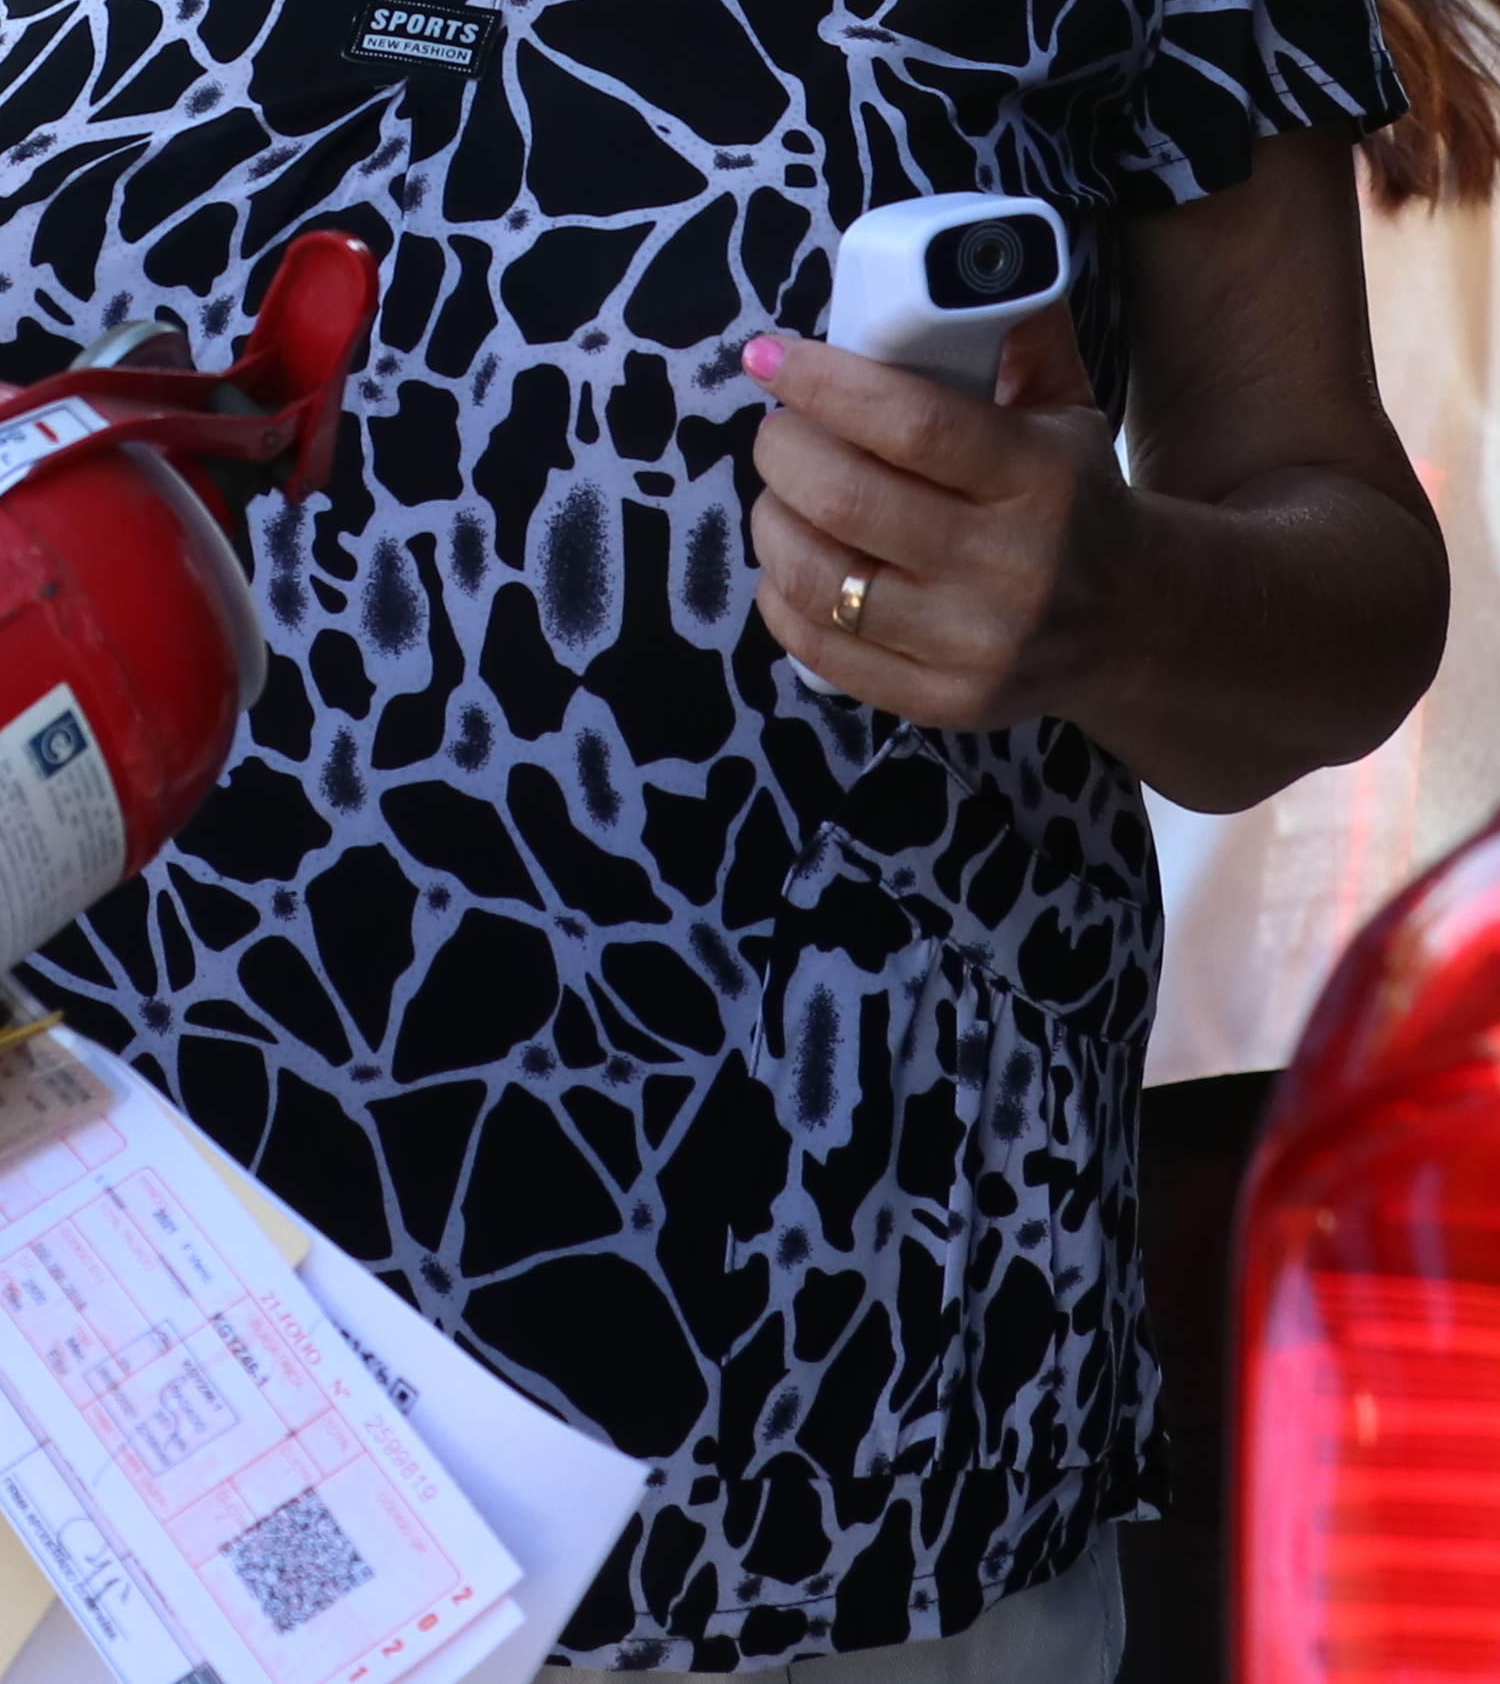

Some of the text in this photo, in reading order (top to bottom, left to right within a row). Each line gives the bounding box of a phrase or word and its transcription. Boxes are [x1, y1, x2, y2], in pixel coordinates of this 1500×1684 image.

[370, 8, 480, 44] SPORTS
[367, 37, 468, 62] NEW FASHION
[362, 1413, 439, 1505] 2599819
